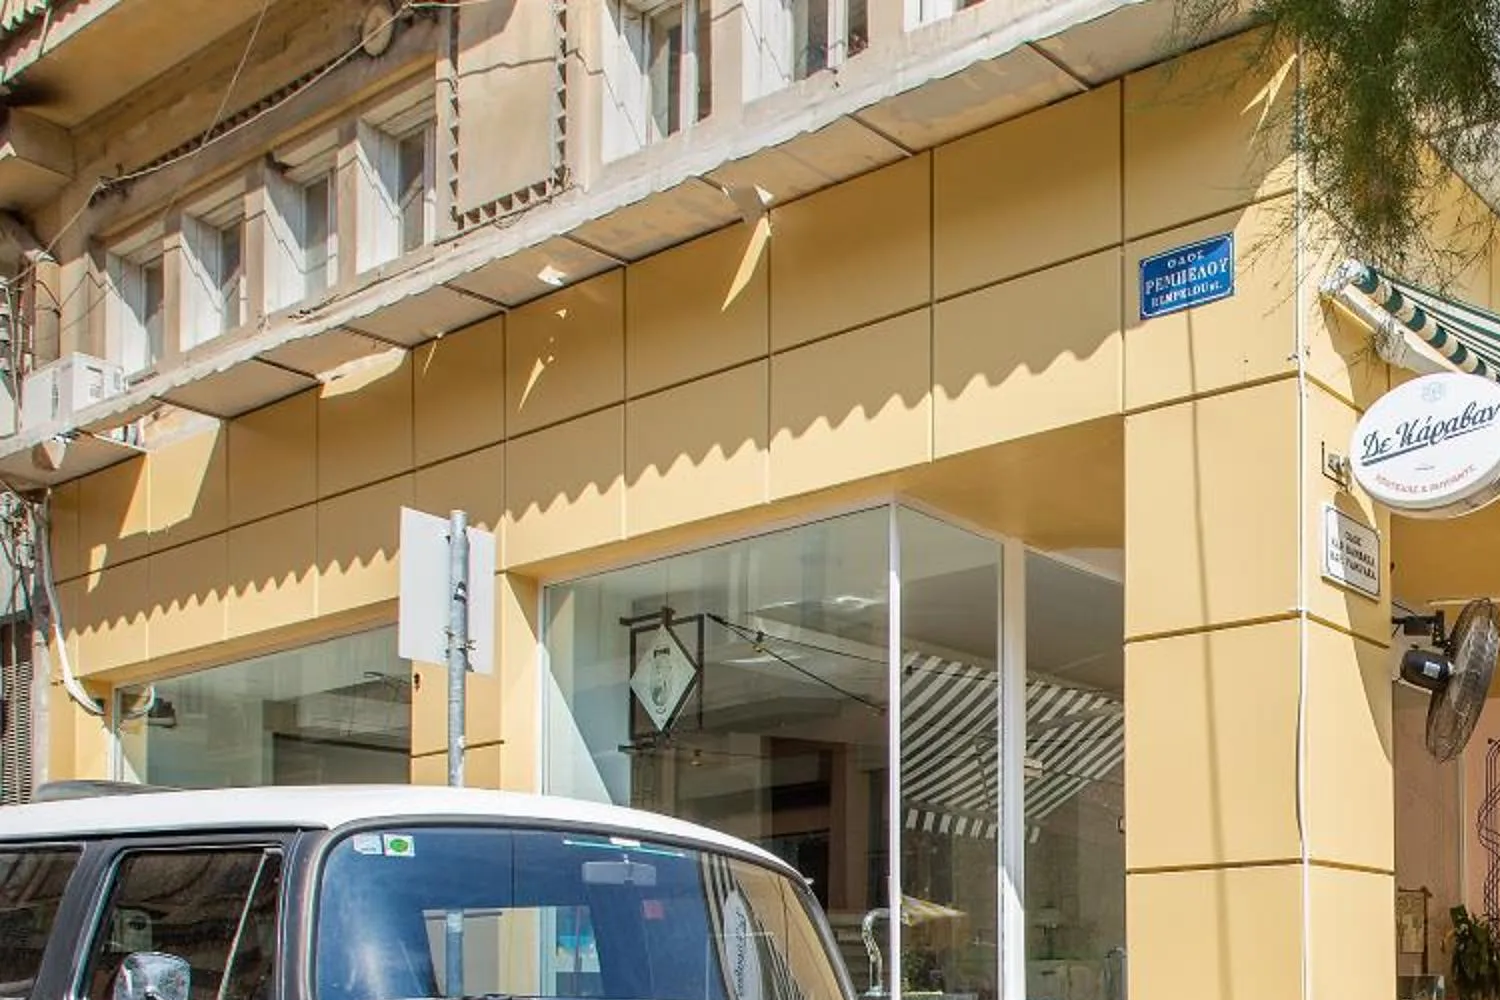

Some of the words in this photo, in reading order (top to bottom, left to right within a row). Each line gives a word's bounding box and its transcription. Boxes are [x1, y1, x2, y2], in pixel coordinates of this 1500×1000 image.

[1145, 257, 1229, 295] ΡΕΜΠΕΛΟΥ
[1167, 250, 1204, 269] ΟΔΟΣ
[1360, 430, 1393, 461] Δε
[1395, 400, 1500, 449] Κάραβαν
